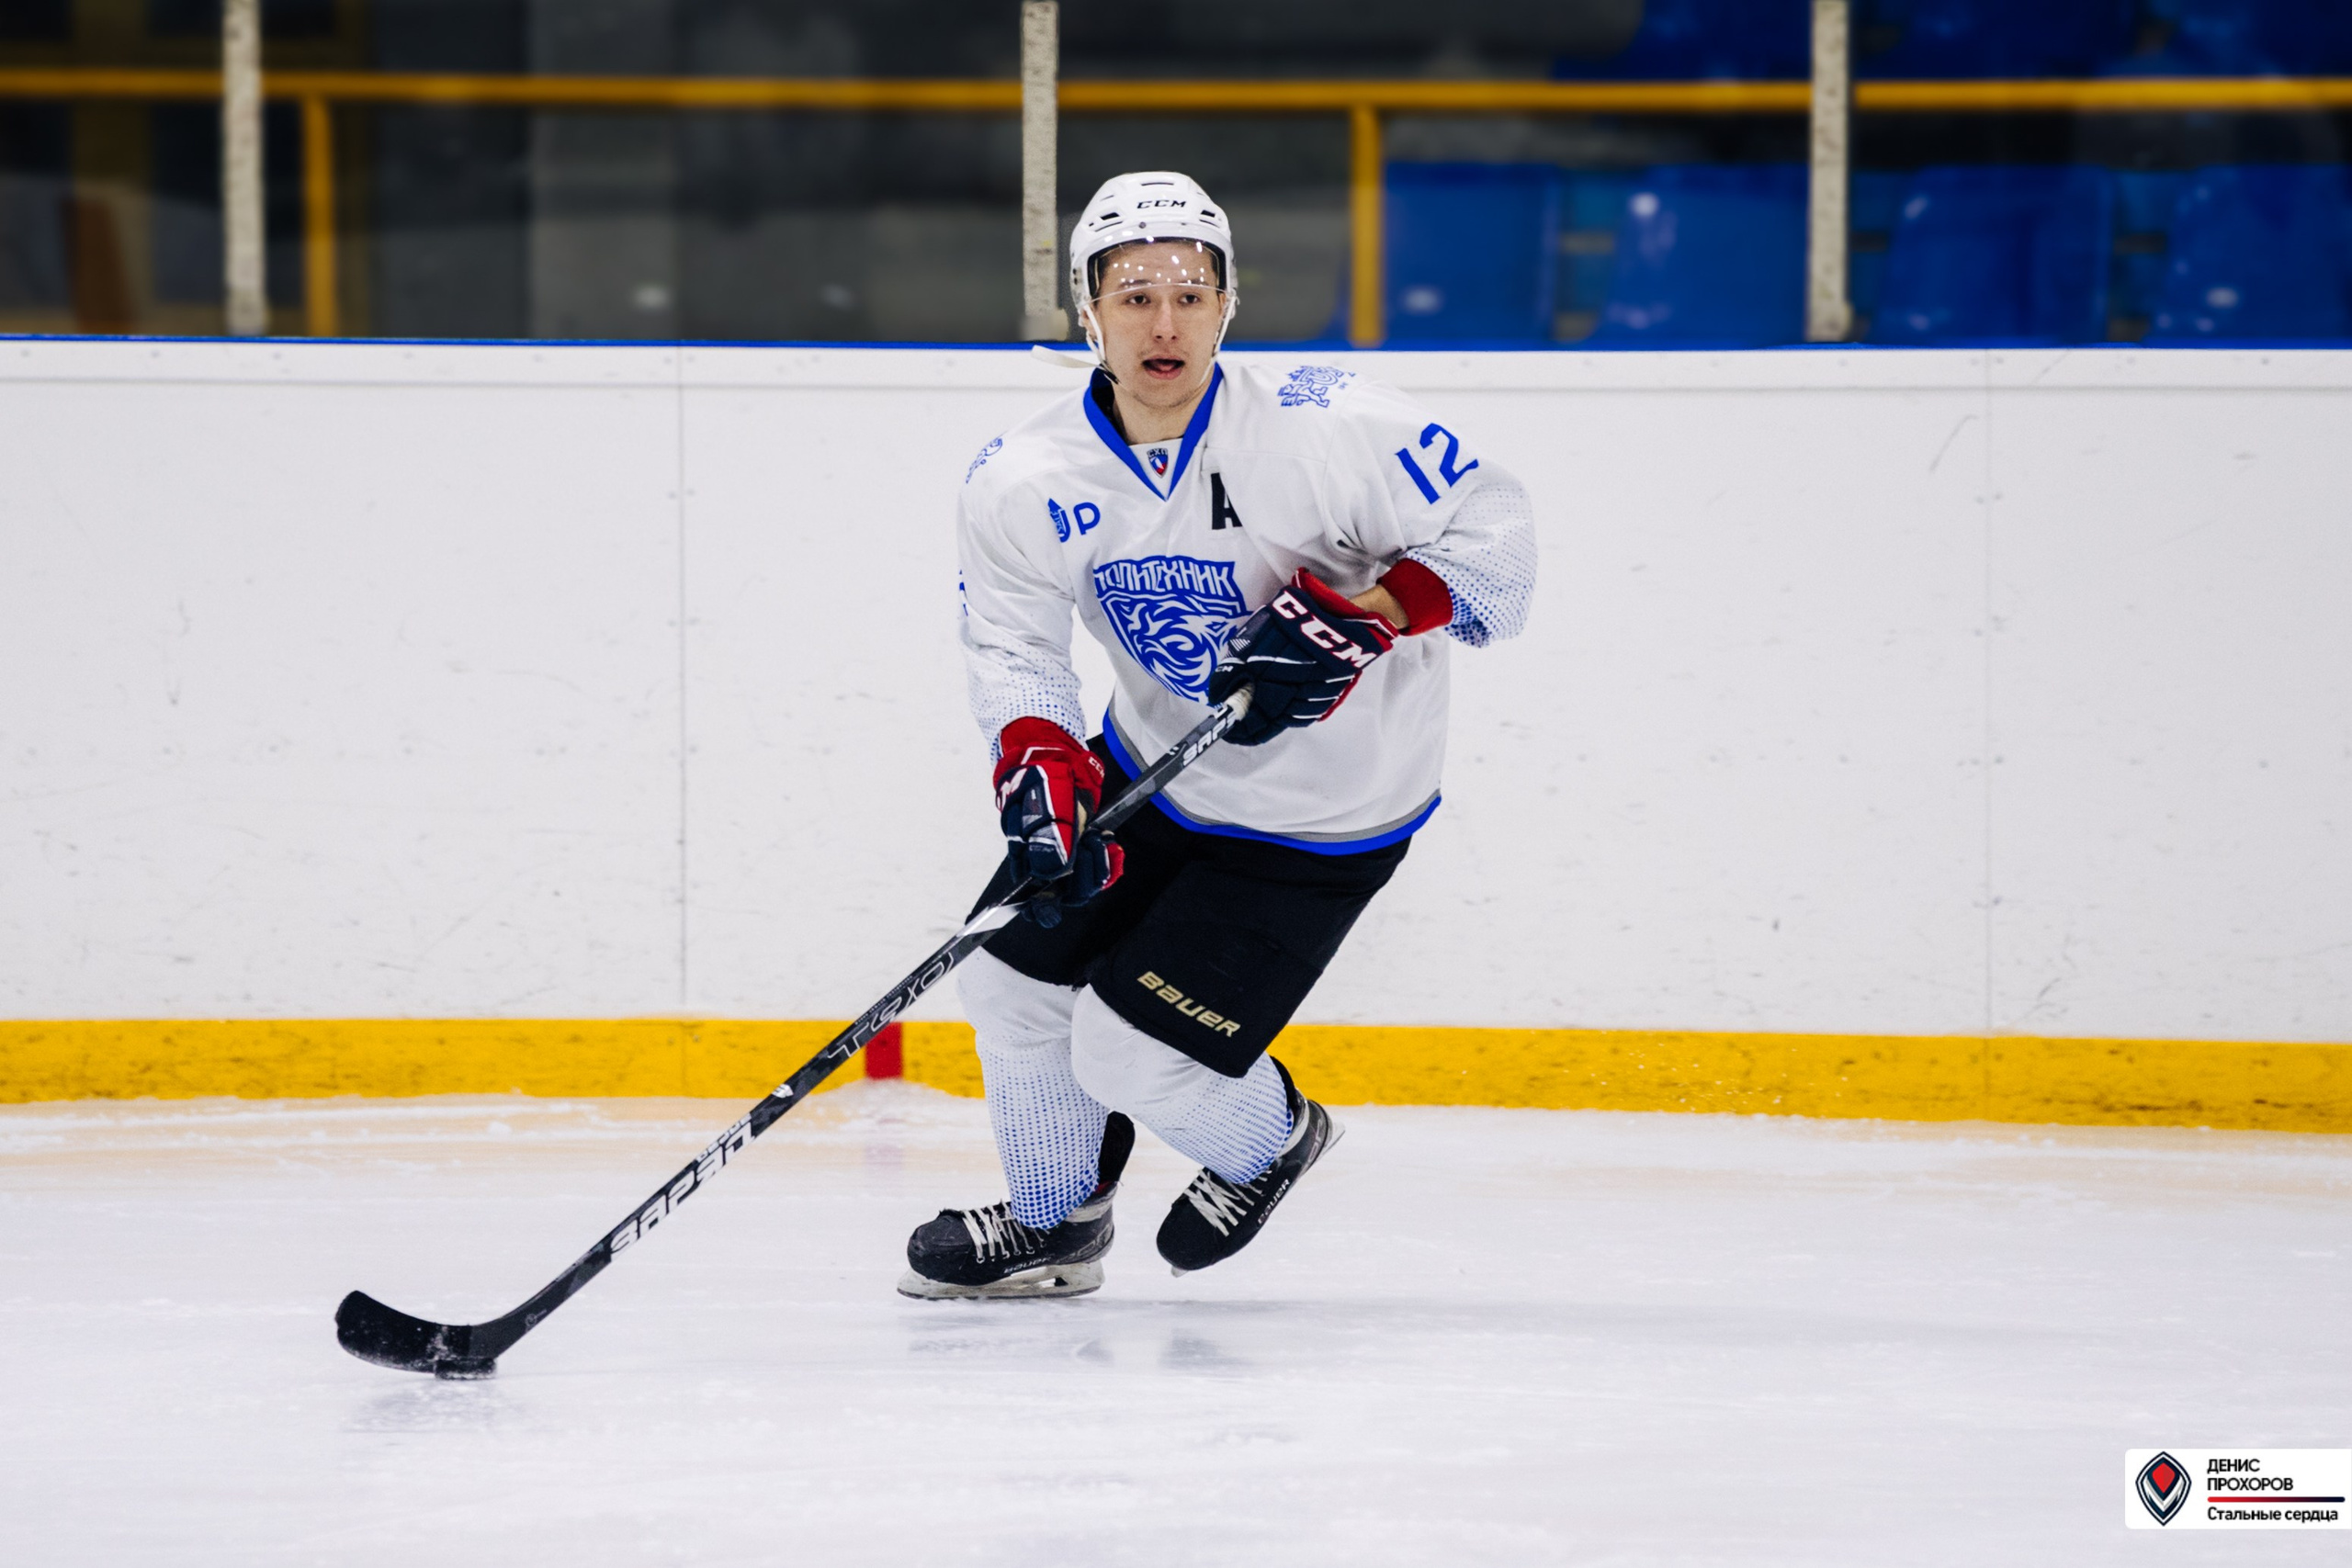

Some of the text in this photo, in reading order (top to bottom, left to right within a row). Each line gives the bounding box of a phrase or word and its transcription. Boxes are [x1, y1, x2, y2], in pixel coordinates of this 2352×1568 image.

[1136, 199, 1187, 209] CCM
[1395, 423, 1479, 505] 12
[1210, 471, 1243, 530] A
[1272, 590, 1378, 669] CCM
[1136, 970, 1241, 1038] BAUER
[1257, 1179, 1291, 1225] BAUER
